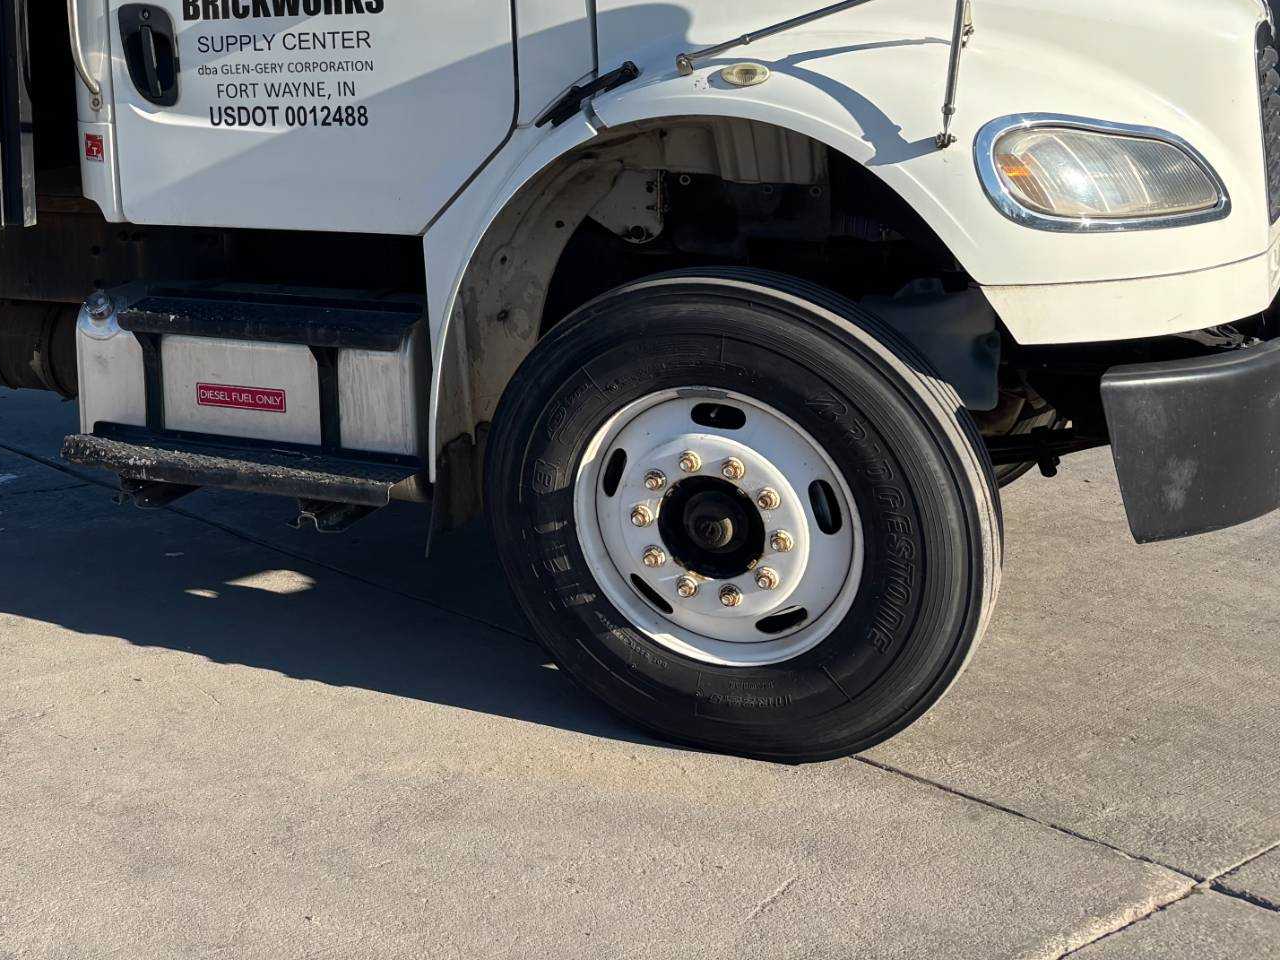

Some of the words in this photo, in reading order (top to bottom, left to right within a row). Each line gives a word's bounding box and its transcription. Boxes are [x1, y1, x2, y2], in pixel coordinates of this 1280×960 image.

[197, 34, 276, 53] SUPPLY
[282, 30, 372, 51] CENTER
[197, 64, 218, 76] dba
[220, 62, 284, 75] GLEN-GERY
[287, 60, 374, 74] CORPORATION
[216, 83, 259, 99] FORT
[264, 81, 333, 100] WAYNE,
[337, 81, 356, 97] IN
[209, 106, 280, 127] USDOT
[284, 105, 369, 127] 0012488
[200, 389, 231, 401] DIESEL
[232, 392, 255, 404] FUEL
[256, 394, 282, 406] ONLY
